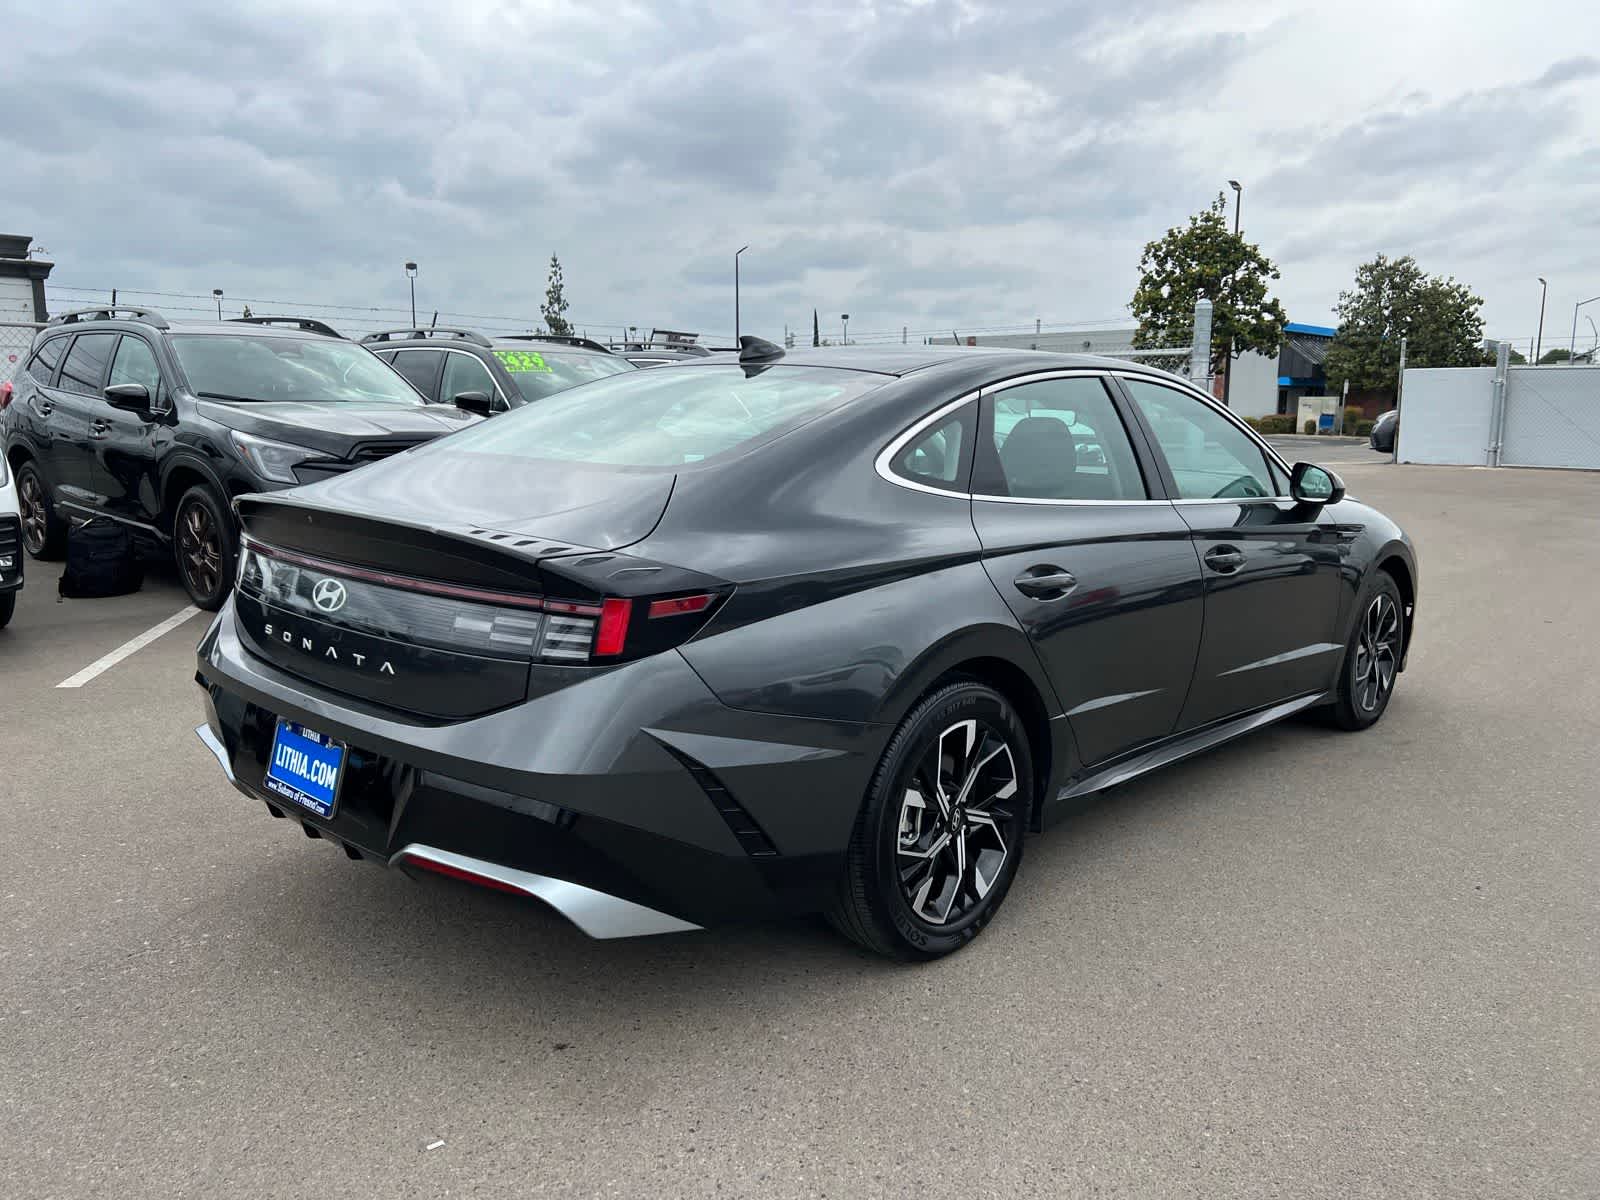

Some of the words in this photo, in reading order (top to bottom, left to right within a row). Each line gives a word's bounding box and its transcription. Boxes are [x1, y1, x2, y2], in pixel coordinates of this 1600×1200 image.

[264, 623, 396, 676] SONATA
[302, 727, 321, 744] LITHIA
[275, 743, 338, 791] LITHIA.COM
